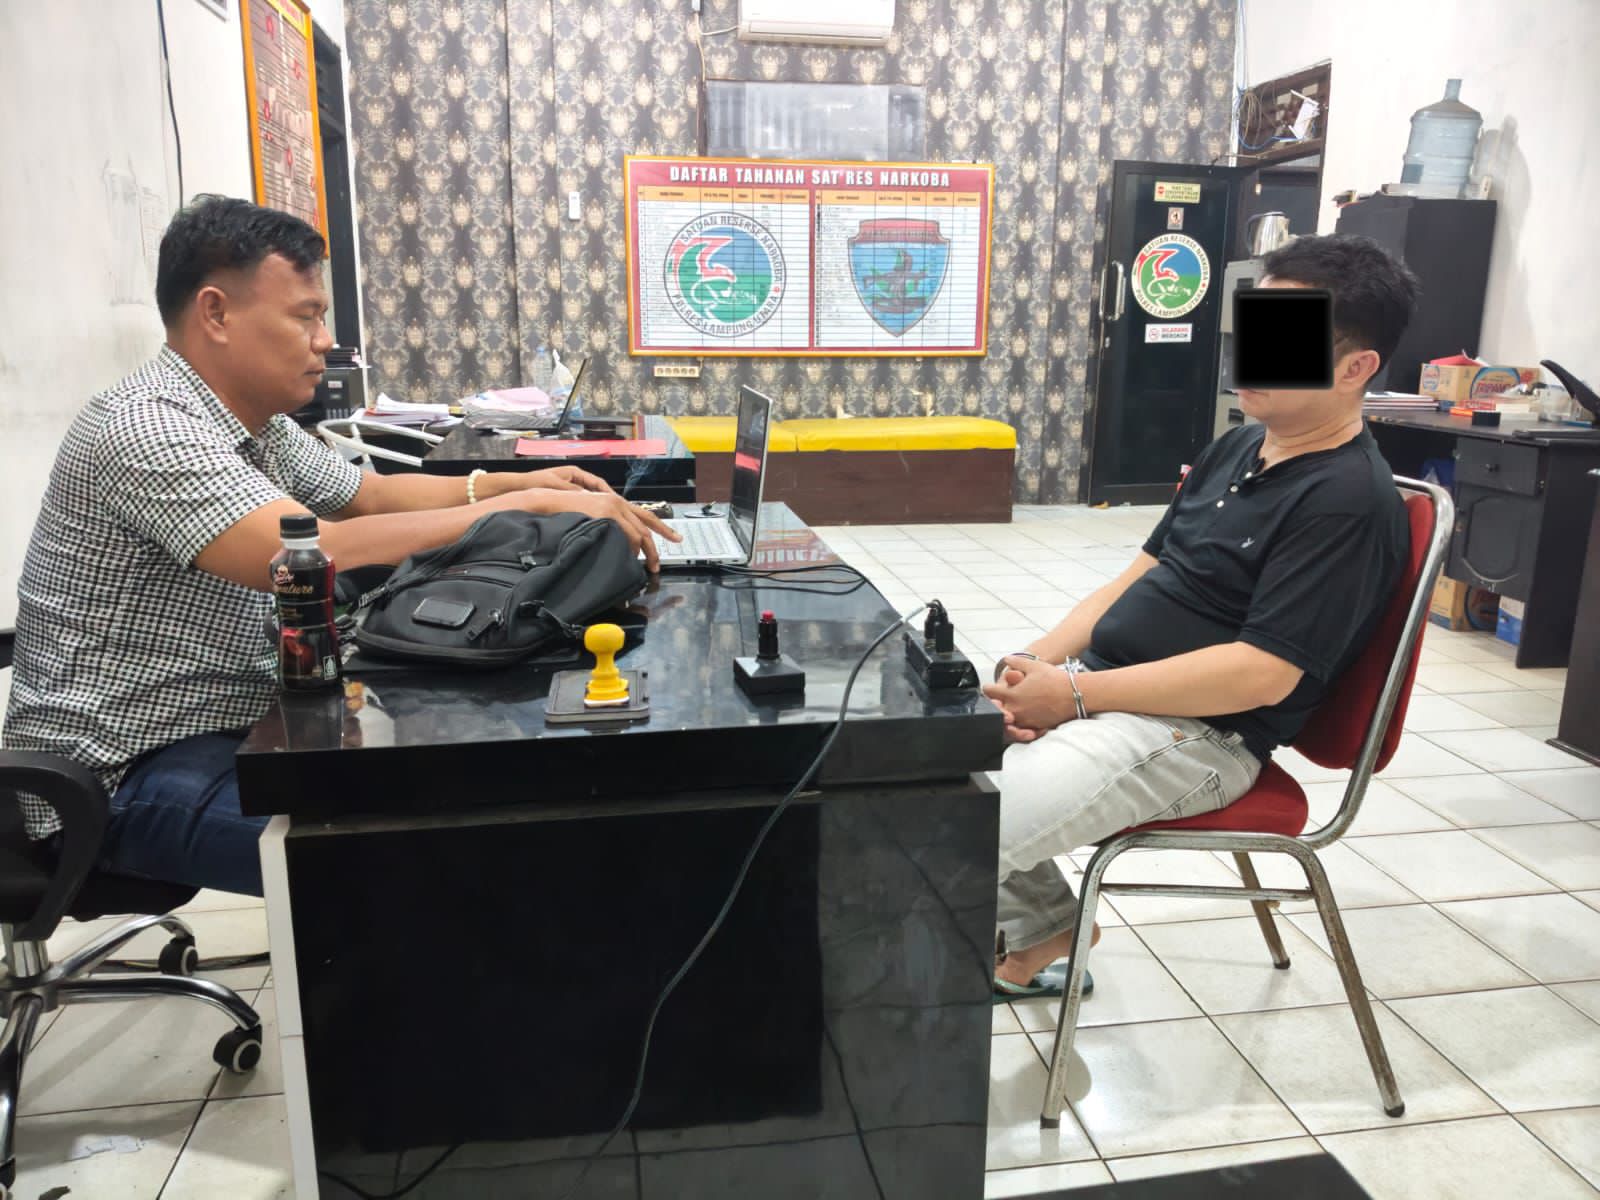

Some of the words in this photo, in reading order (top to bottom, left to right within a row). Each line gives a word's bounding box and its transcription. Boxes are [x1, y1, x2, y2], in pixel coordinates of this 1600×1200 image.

[670, 166, 728, 182] DAFTAR
[735, 168, 804, 184] TAHANAN
[880, 171, 949, 187] NARKOBA
[680, 216, 717, 242] SATUAN
[720, 216, 762, 236] RESERSE
[760, 235, 783, 281] NARKOBA
[673, 294, 703, 327] POLRES
[703, 320, 754, 335] LAMPUNG
[752, 294, 778, 324] UTARA
